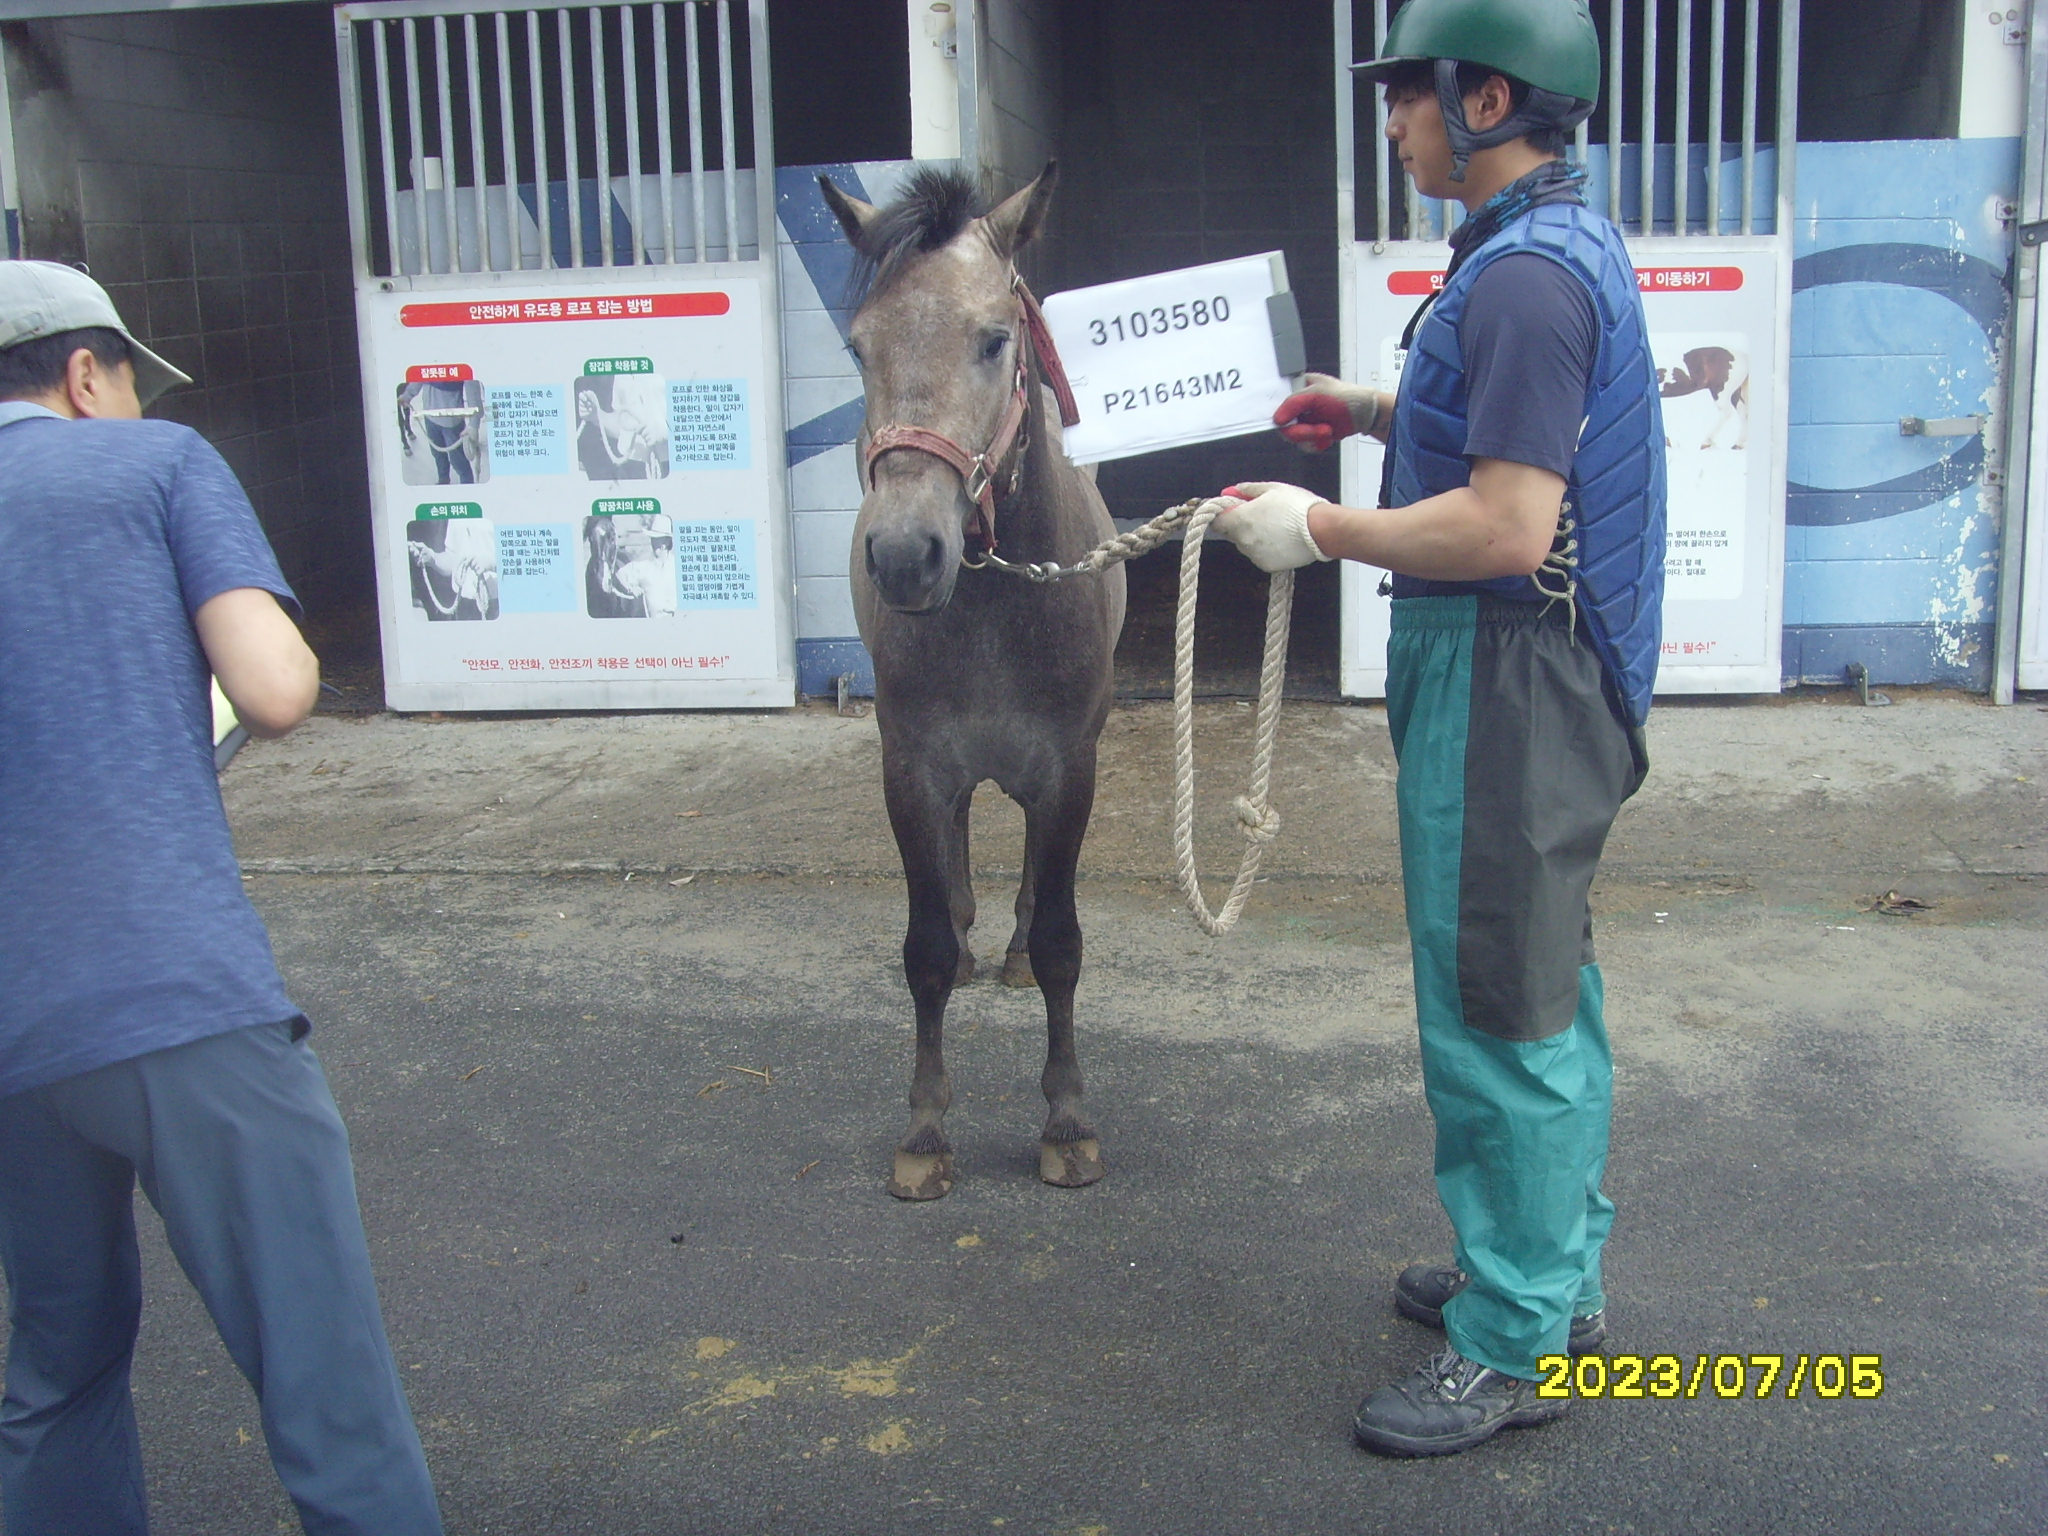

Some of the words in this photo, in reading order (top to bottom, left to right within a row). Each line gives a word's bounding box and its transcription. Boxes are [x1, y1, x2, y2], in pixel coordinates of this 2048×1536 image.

[1637, 271, 1651, 287] 게
[1655, 271, 1710, 287] 이동하기
[469, 304, 519, 319] 안전하게
[524, 302, 562, 317] 유도용
[567, 302, 592, 315] 로프
[597, 300, 622, 314] 잡는
[627, 298, 652, 313] 방법
[1088, 295, 1231, 346] 3103580
[589, 362, 612, 372] 장갑을
[615, 361, 638, 371] 착용할
[641, 360, 649, 370] 것
[421, 368, 446, 378] 잘못된
[449, 367, 459, 377] 예
[1104, 368, 1243, 414] P21643M2
[430, 506, 447, 516] 손의
[451, 505, 468, 515] 위치
[598, 502, 633, 511] 팔꿈치의
[637, 501, 654, 511] 사용
[549, 658, 593, 669] 안전조끼
[597, 657, 629, 669] 착용은
[634, 657, 667, 668] 선택이
[672, 657, 693, 668] 아닌
